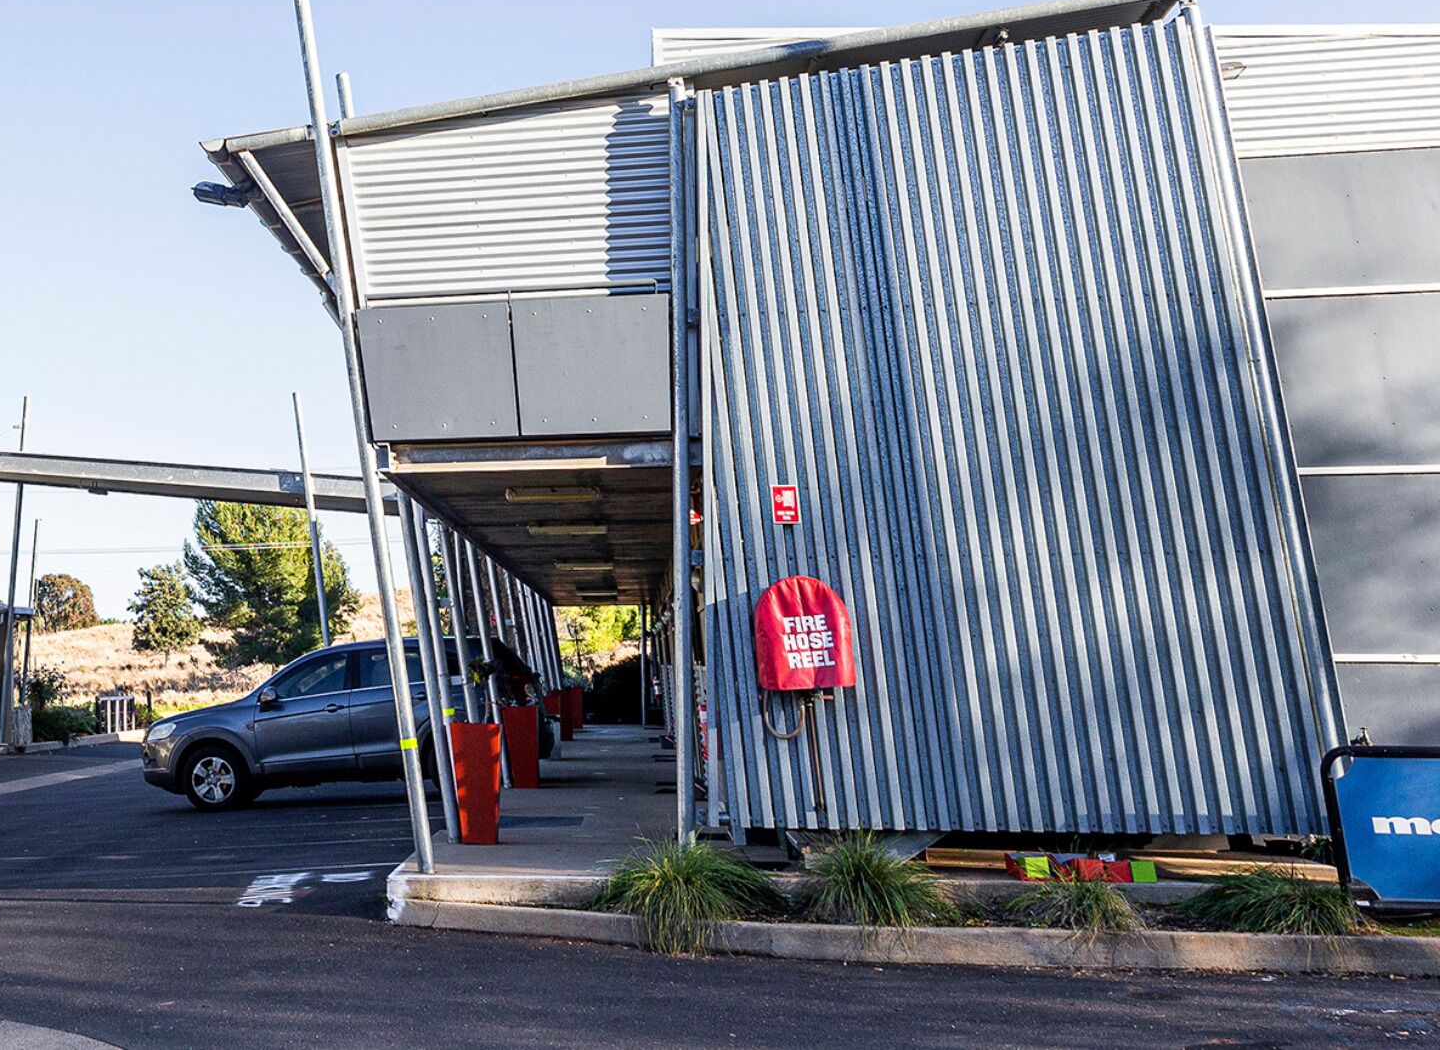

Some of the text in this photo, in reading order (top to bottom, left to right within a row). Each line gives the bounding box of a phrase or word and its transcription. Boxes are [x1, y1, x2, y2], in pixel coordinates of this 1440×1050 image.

[783, 614, 828, 633] FIRE
[782, 631, 835, 651] HOSE
[787, 650, 836, 669] REEL
